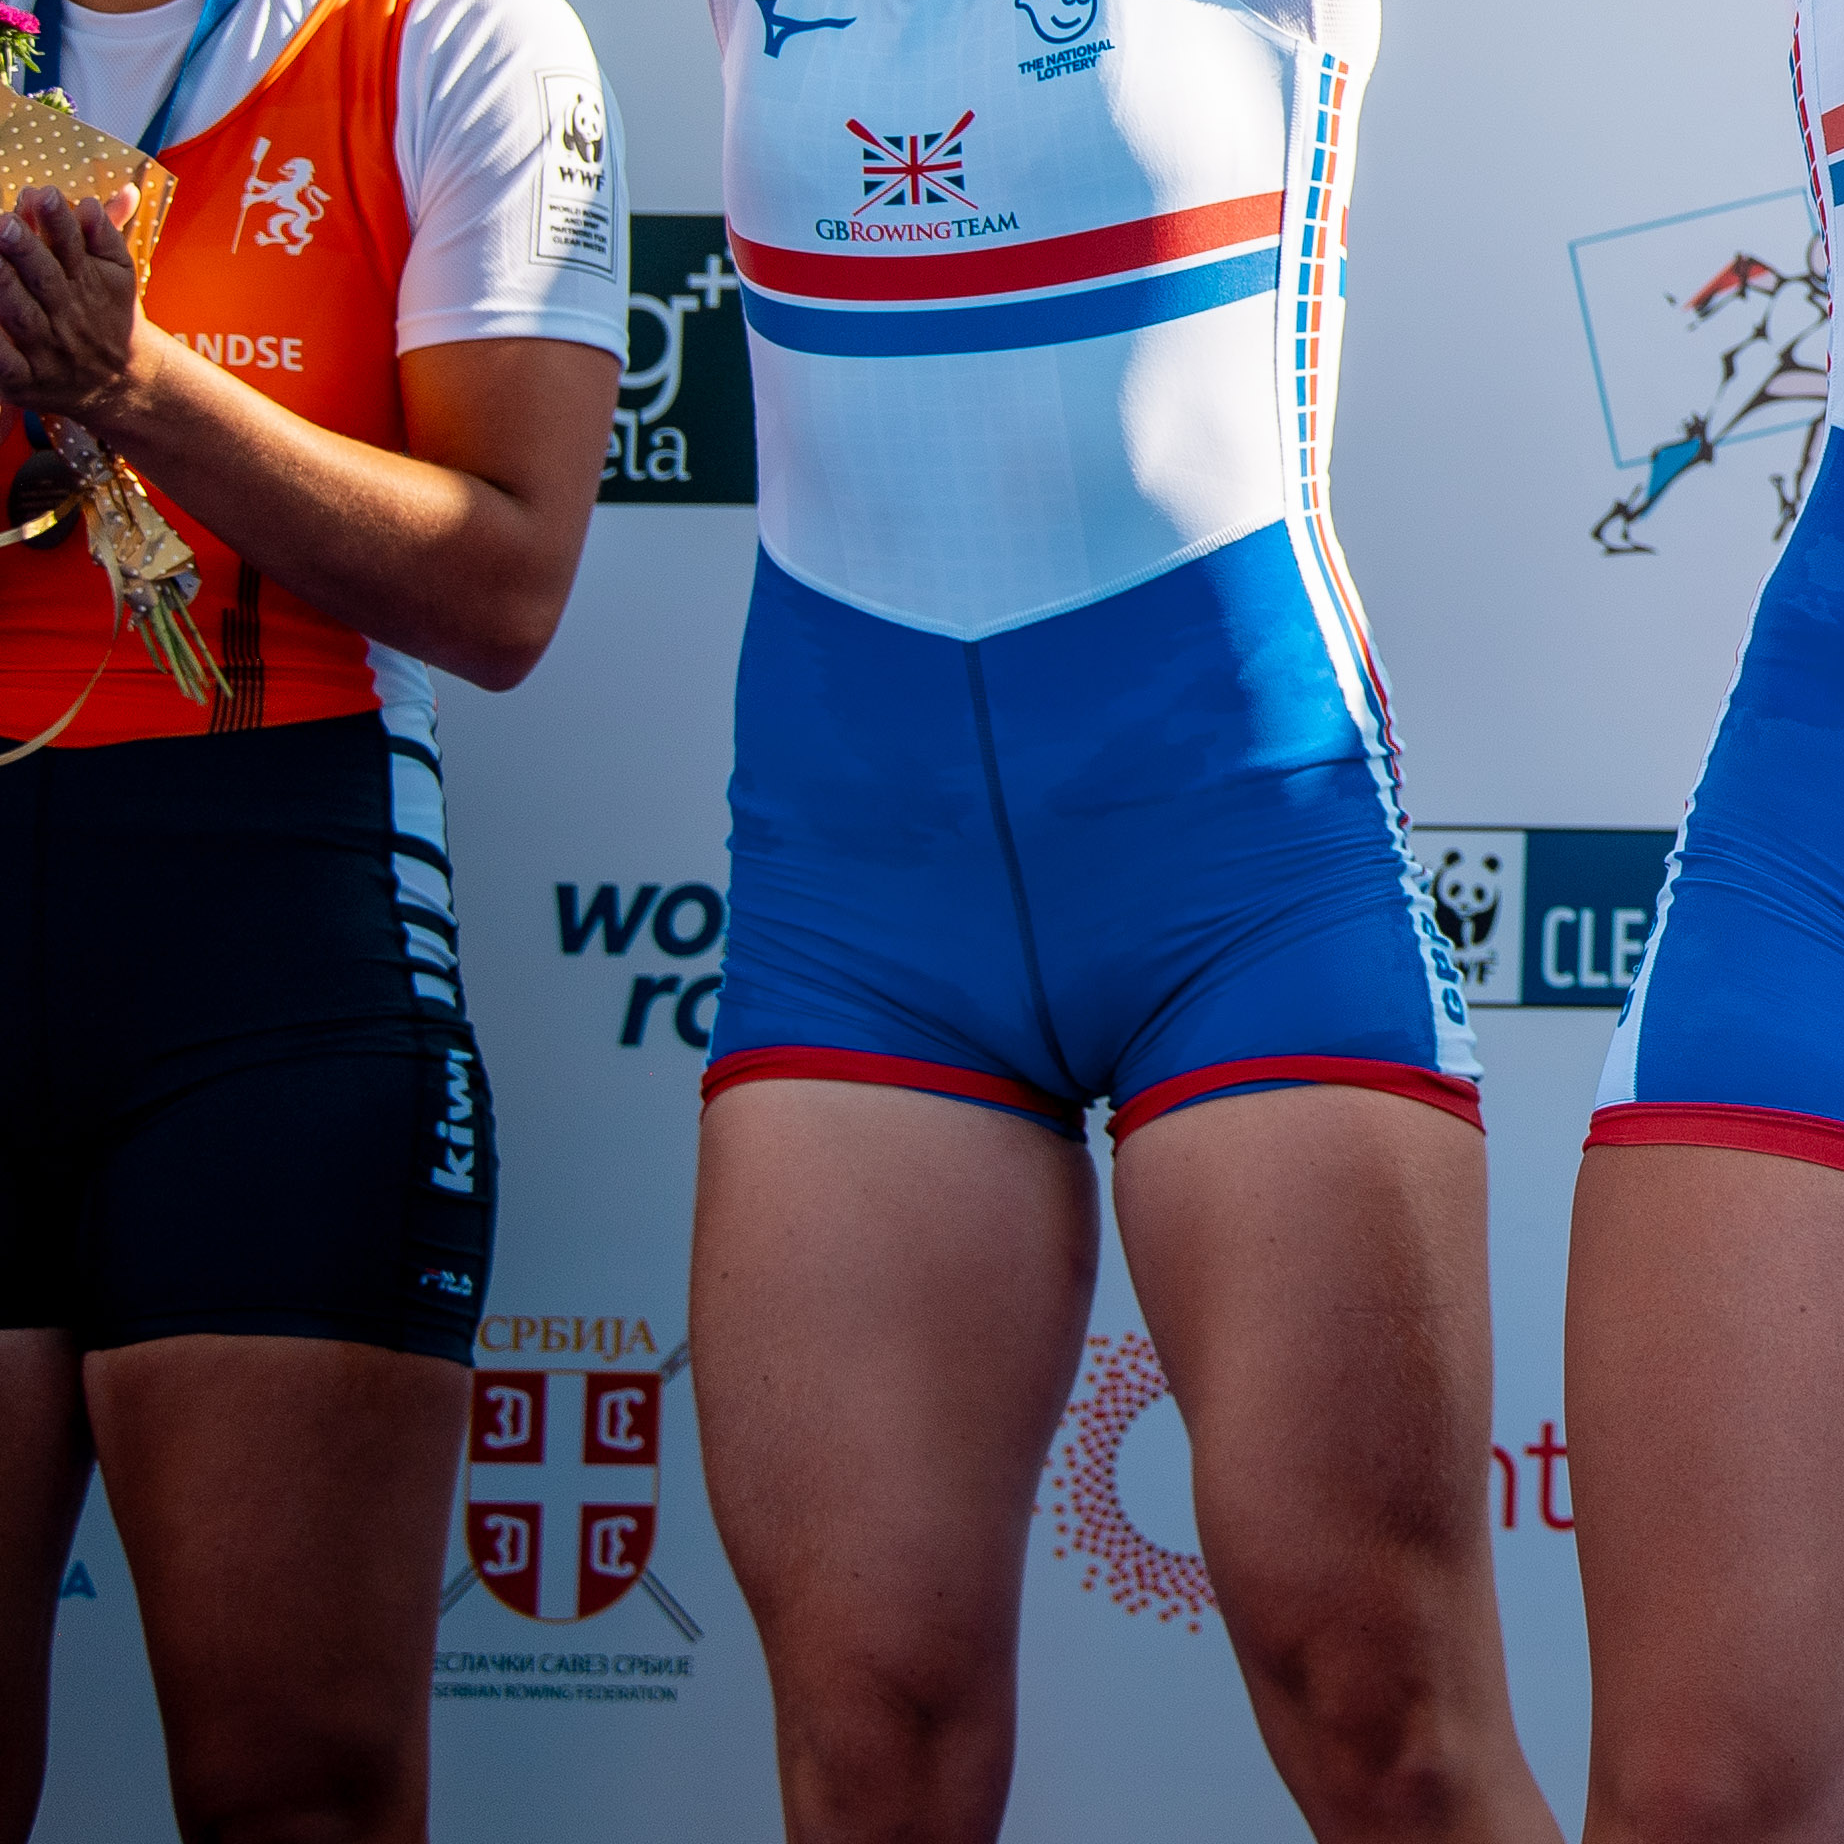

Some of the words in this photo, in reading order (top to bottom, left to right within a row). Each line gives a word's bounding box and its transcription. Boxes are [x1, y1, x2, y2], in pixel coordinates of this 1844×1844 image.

[1018, 57, 1045, 74] THE
[1045, 39, 1115, 66] NATIONAL
[1036, 55, 1097, 82] LOTTERY
[559, 165, 606, 192] WWF
[476, 1313, 659, 1363] СРБИЈА
